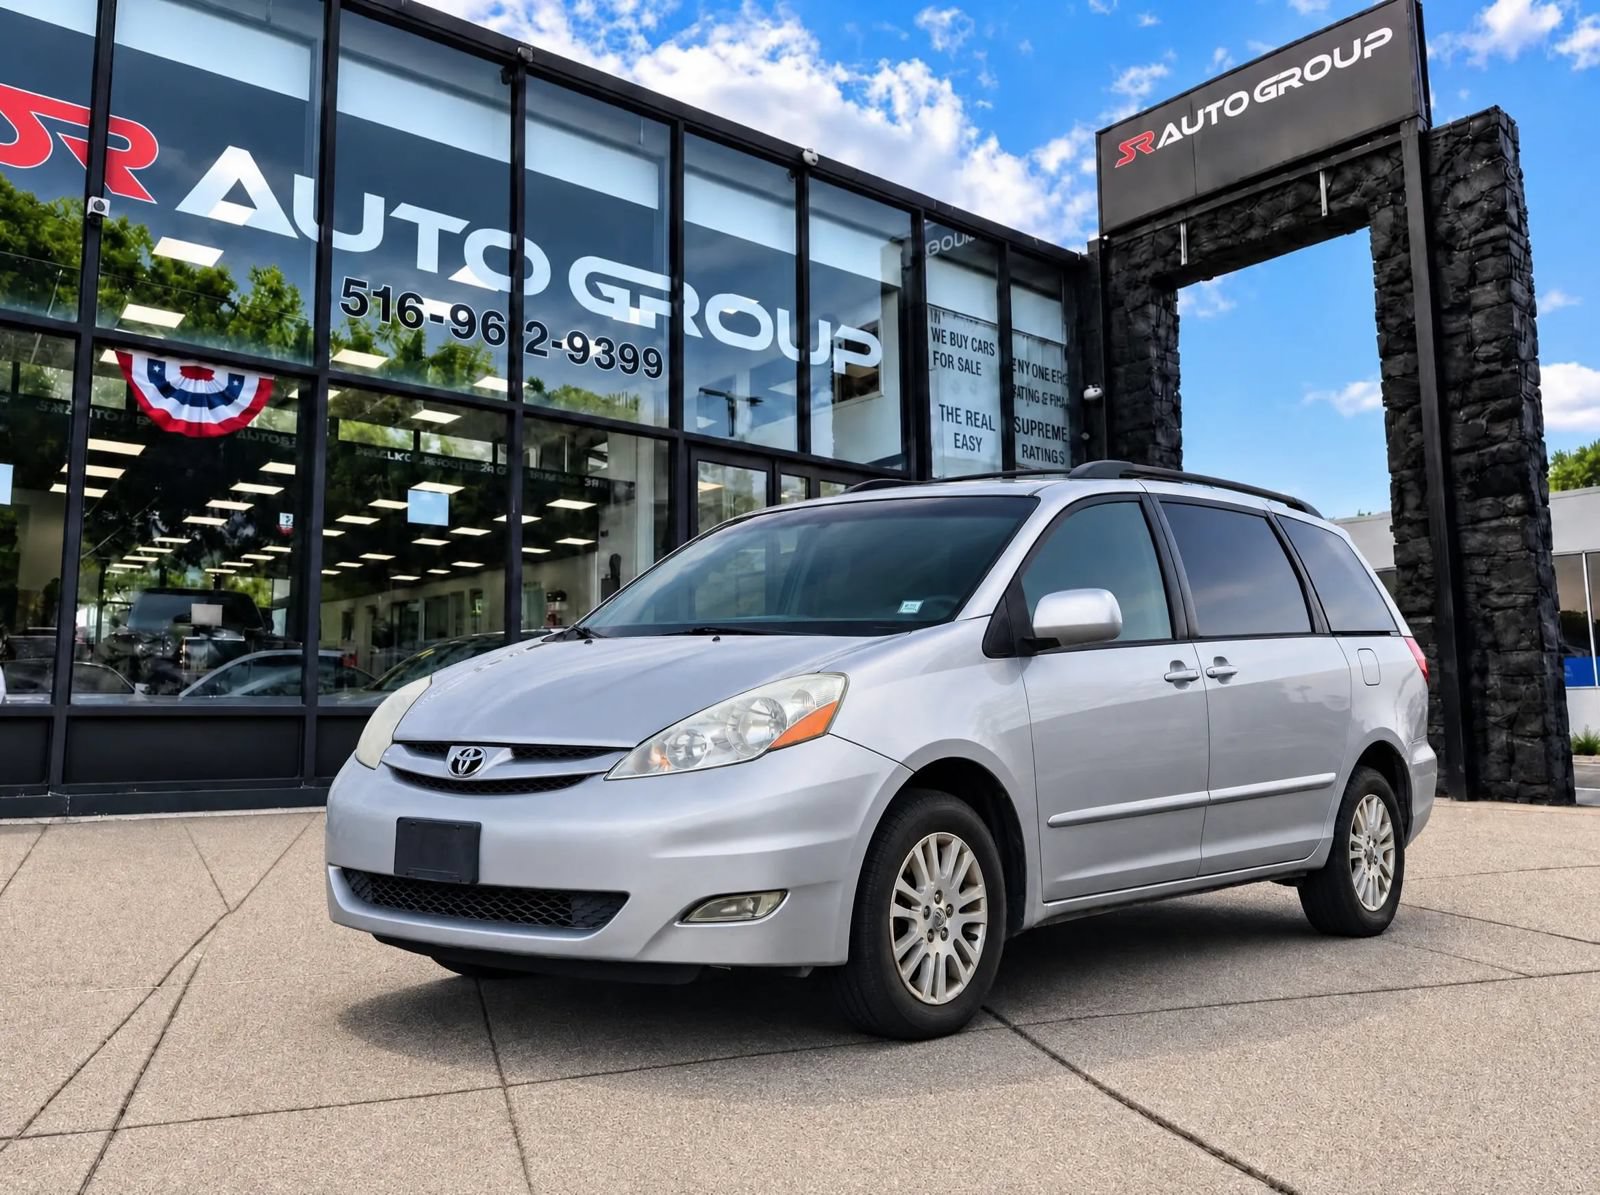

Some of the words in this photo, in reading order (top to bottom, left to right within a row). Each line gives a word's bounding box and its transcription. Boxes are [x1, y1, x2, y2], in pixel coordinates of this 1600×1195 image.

[1114, 130, 1156, 168] SR
[1156, 90, 1250, 150] AUTO
[1254, 27, 1393, 103] GROUP
[175, 145, 551, 297] AUTO
[568, 255, 882, 374] GROUP
[931, 326, 947, 345] WE
[950, 331, 969, 350] BUY
[971, 337, 995, 357] CARS
[933, 350, 955, 370] FOR
[957, 356, 982, 376] SALE
[938, 403, 962, 425] THE
[965, 409, 996, 432] REAL
[1014, 415, 1068, 442] SUPREME
[954, 432, 982, 453] EASY
[1021, 443, 1065, 465] RATINGS
